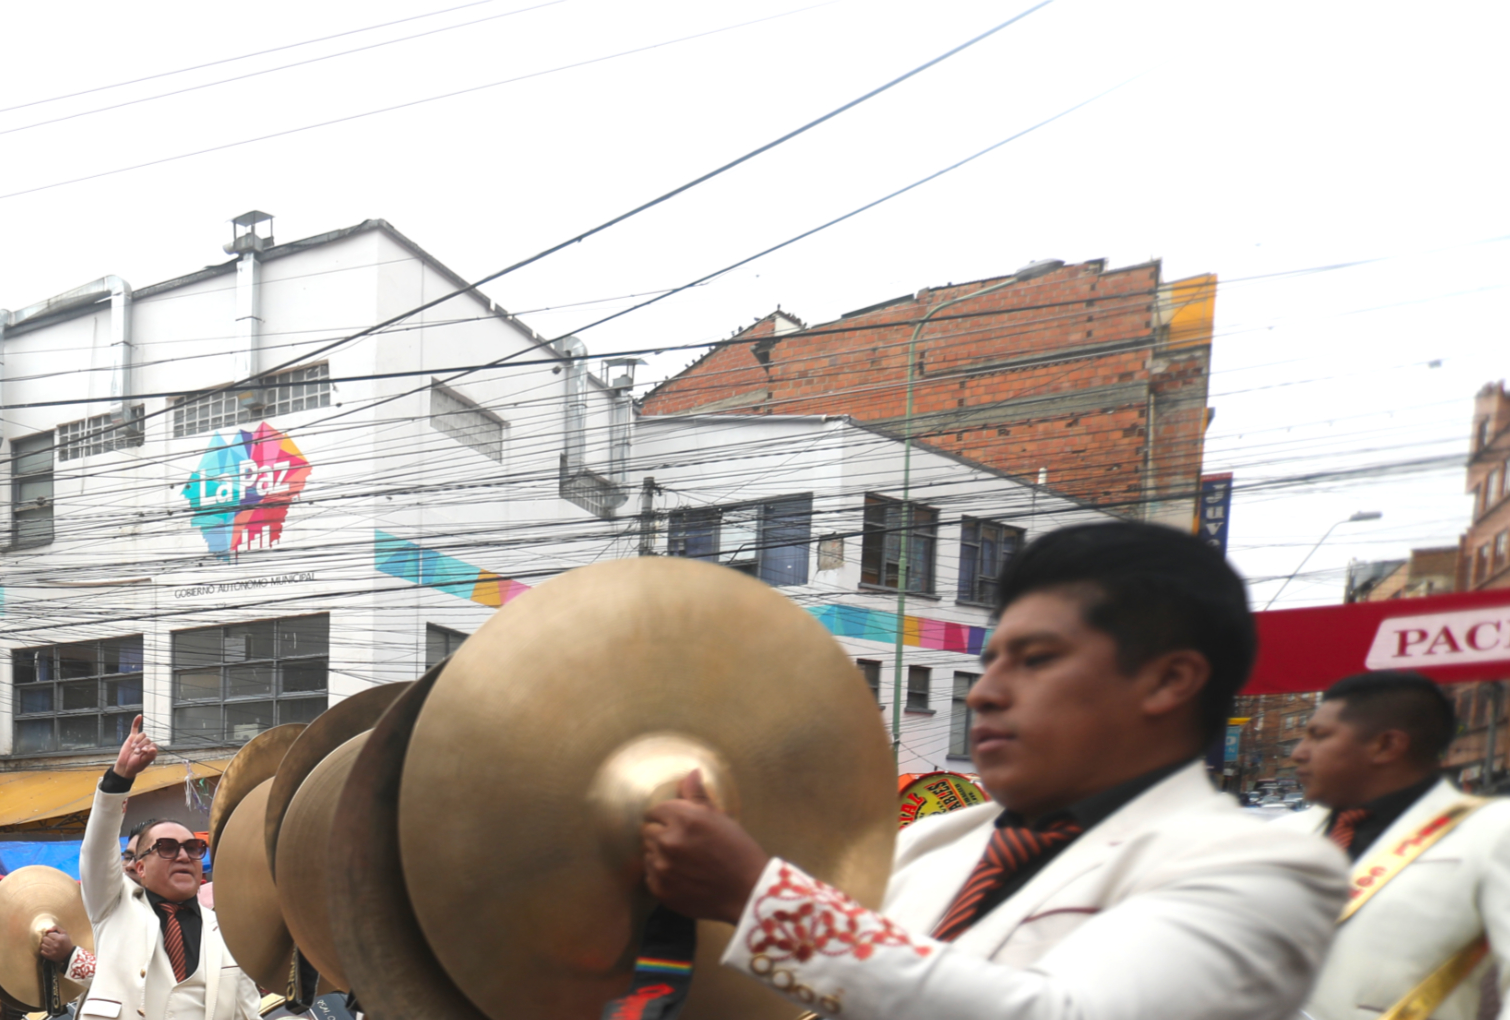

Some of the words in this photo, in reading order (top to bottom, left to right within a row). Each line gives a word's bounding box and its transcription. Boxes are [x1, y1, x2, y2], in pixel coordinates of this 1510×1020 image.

[174, 585, 215, 599] GOBIERNO
[1392, 619, 1510, 658] PAC
[927, 781, 962, 811] ABLES
